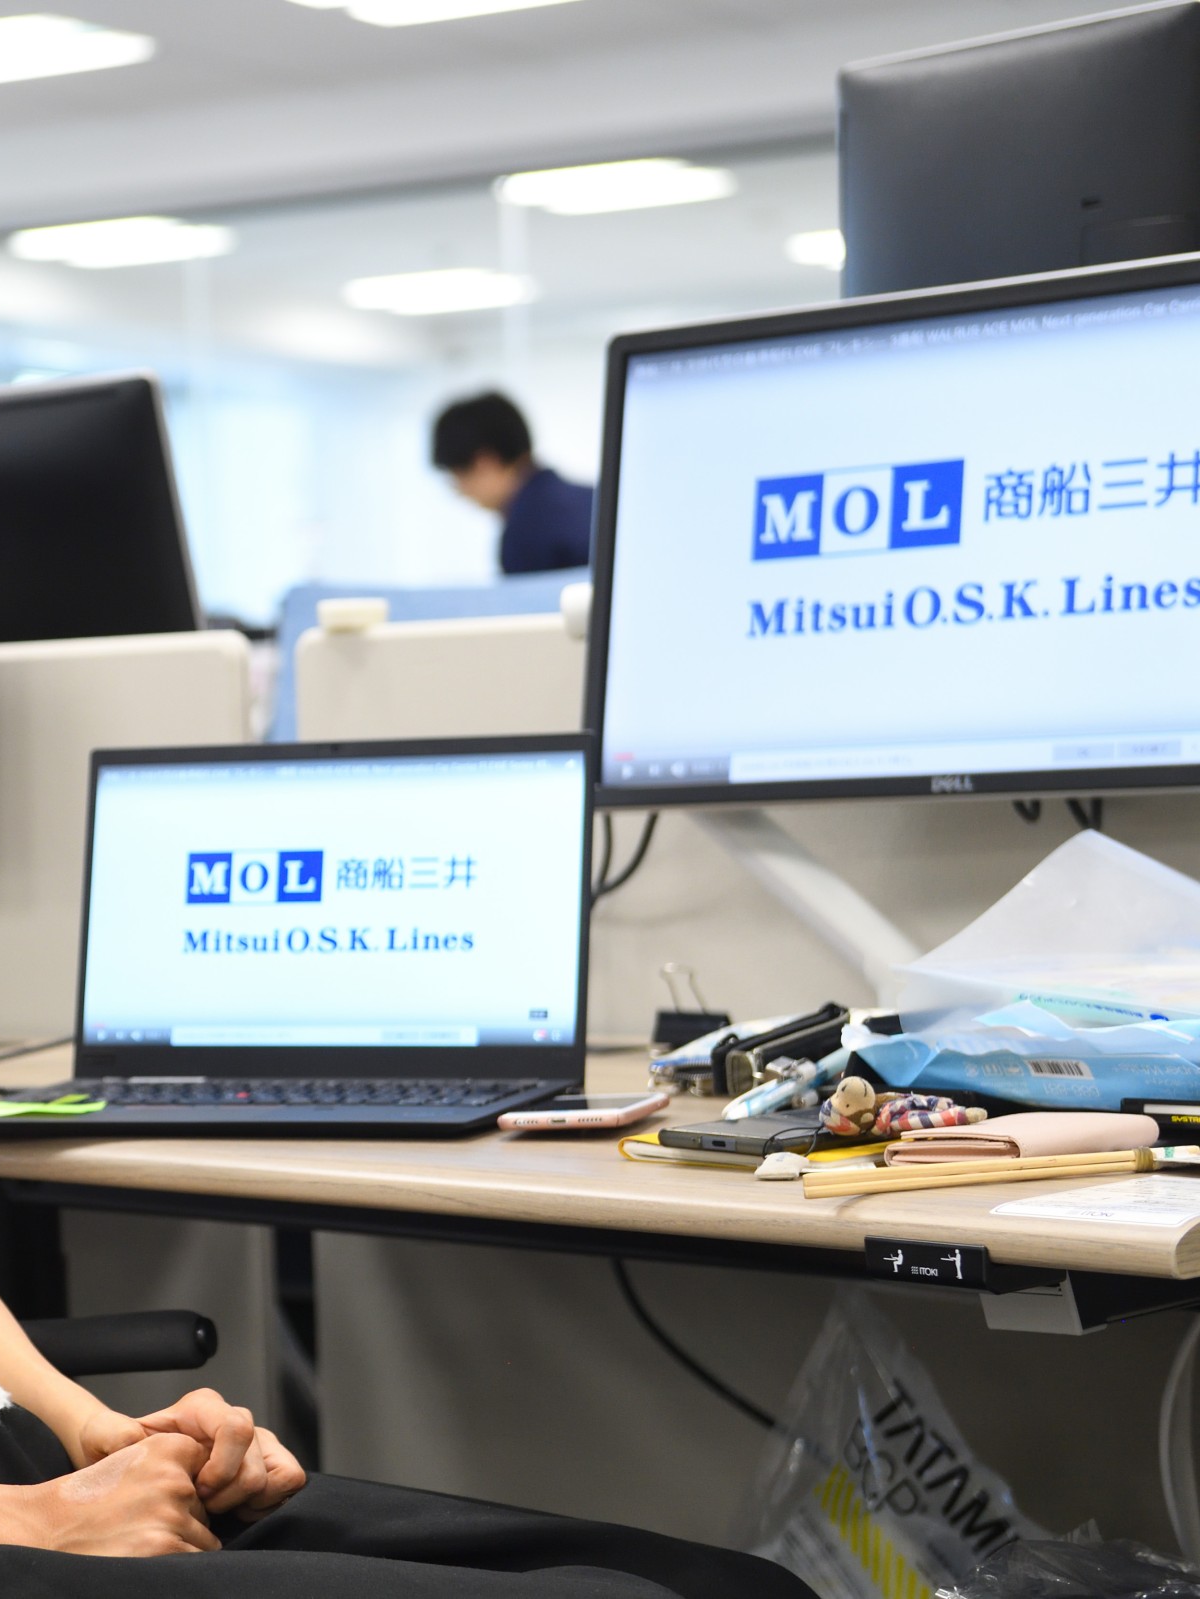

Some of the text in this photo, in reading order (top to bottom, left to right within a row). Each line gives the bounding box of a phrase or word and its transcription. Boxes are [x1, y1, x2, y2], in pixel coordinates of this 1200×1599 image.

[757, 450, 1200, 546] MOL 商船三井
[1059, 574, 1200, 617] Lines
[188, 853, 477, 896] MOL 商船三井
[385, 926, 475, 952] Lines
[919, 1266, 939, 1277] ITOKI
